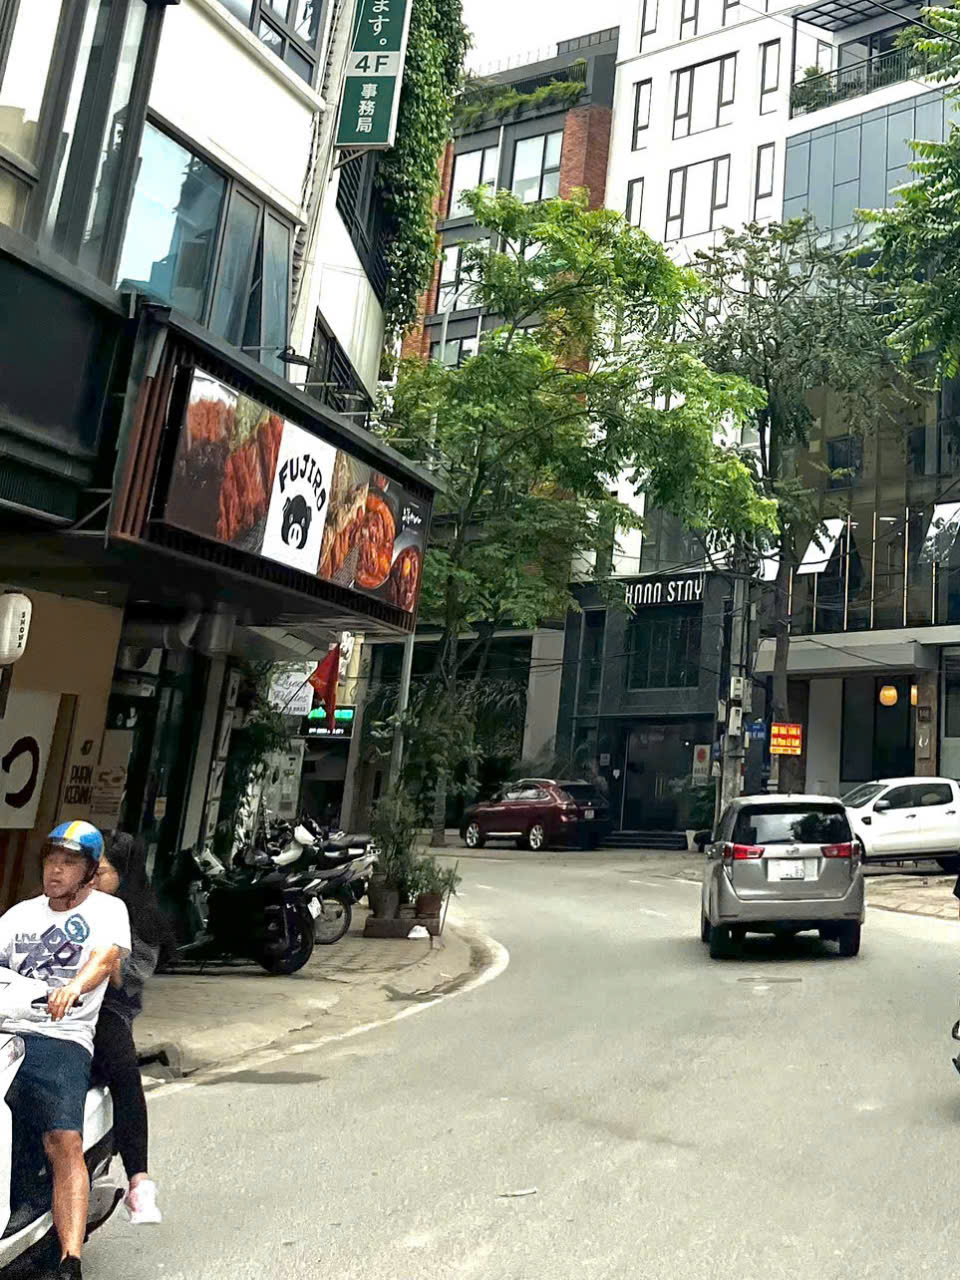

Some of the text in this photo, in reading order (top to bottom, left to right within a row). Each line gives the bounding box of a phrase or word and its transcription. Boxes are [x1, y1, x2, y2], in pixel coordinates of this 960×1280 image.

[355, 55, 389, 73] 4F
[356, 83, 378, 133] 事務局
[279, 454, 326, 511] FUJIRO
[625, 580, 702, 604] HANA STAY
